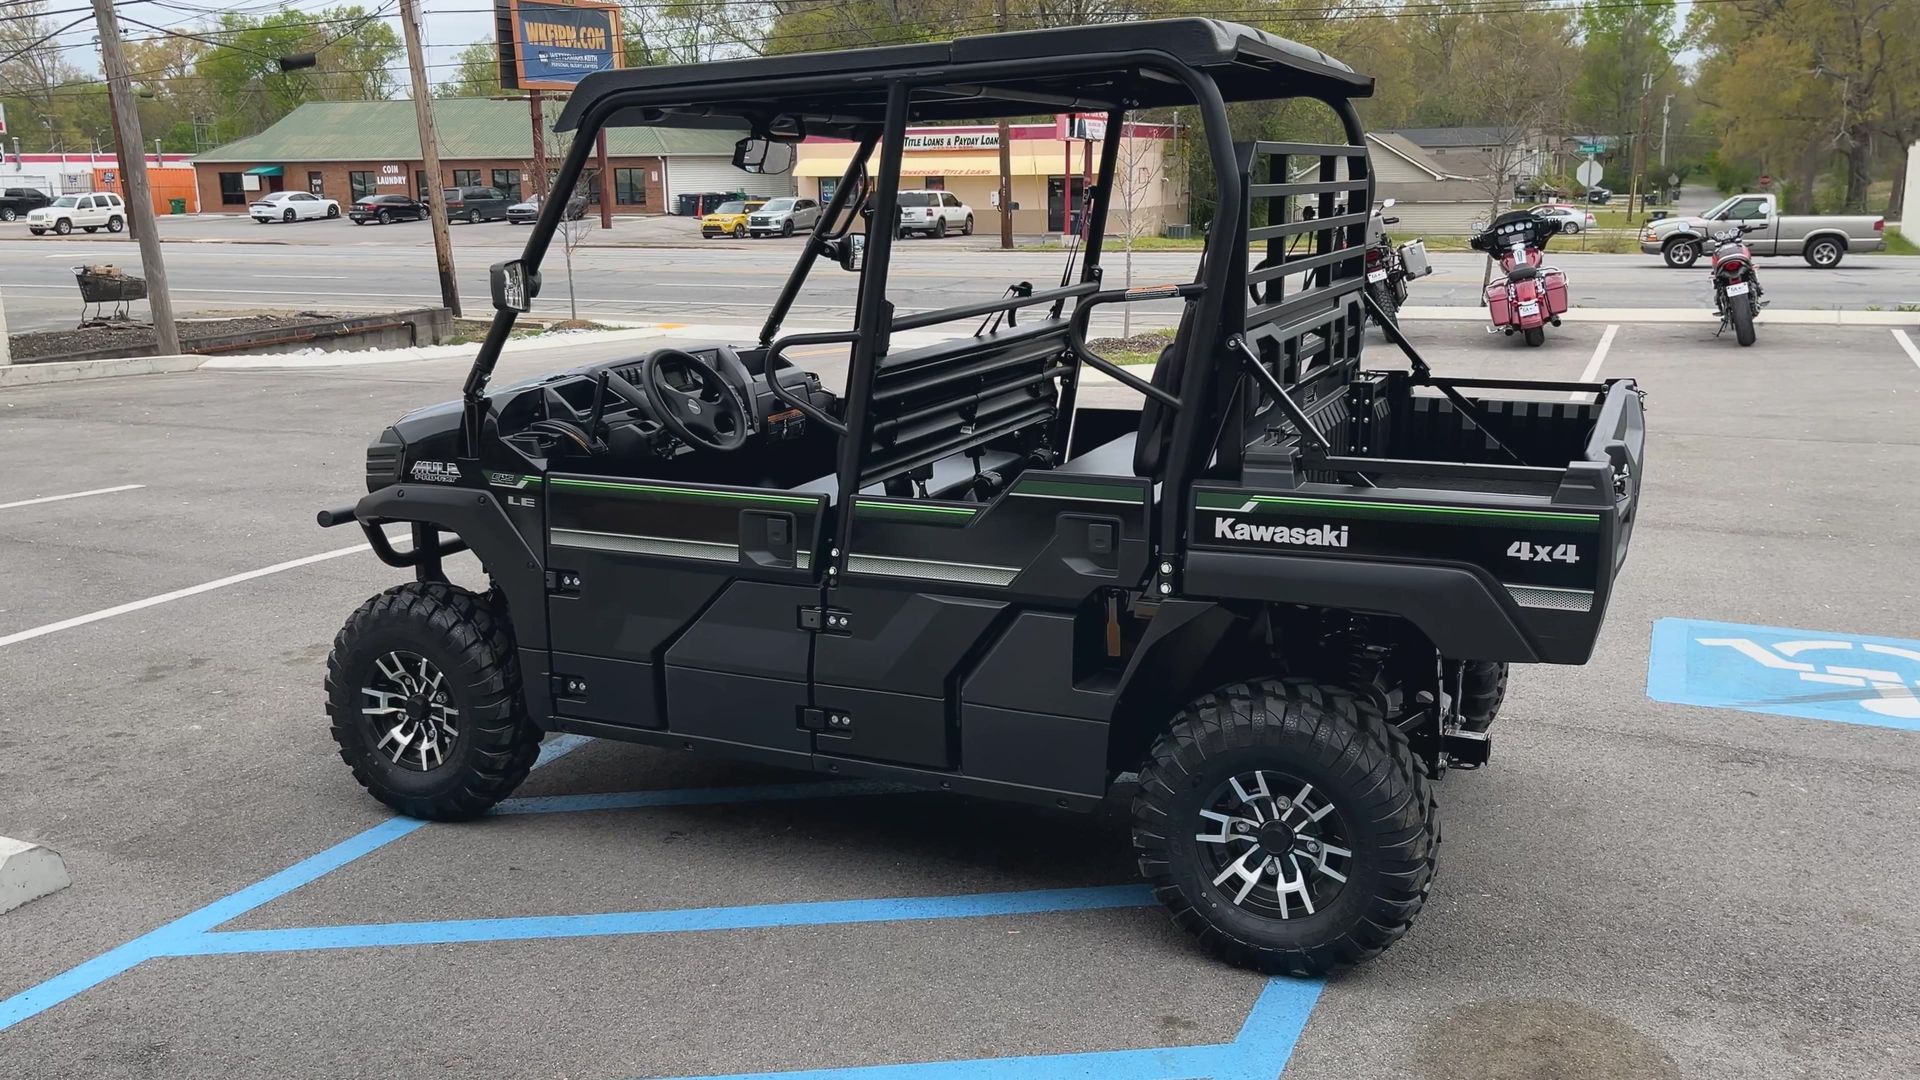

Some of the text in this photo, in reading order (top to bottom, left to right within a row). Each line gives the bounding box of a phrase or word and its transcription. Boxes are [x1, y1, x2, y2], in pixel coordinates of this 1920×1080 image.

[524, 21, 606, 50] WKFIRM.COM
[980, 134, 1000, 146] LOAN
[382, 165, 399, 174] COIN
[376, 176, 407, 185] LAUNDRY
[410, 460, 462, 478] MULE
[507, 495, 536, 508] LE
[1215, 517, 1349, 547] Kawasaki
[1506, 541, 1580, 564] 4x4
